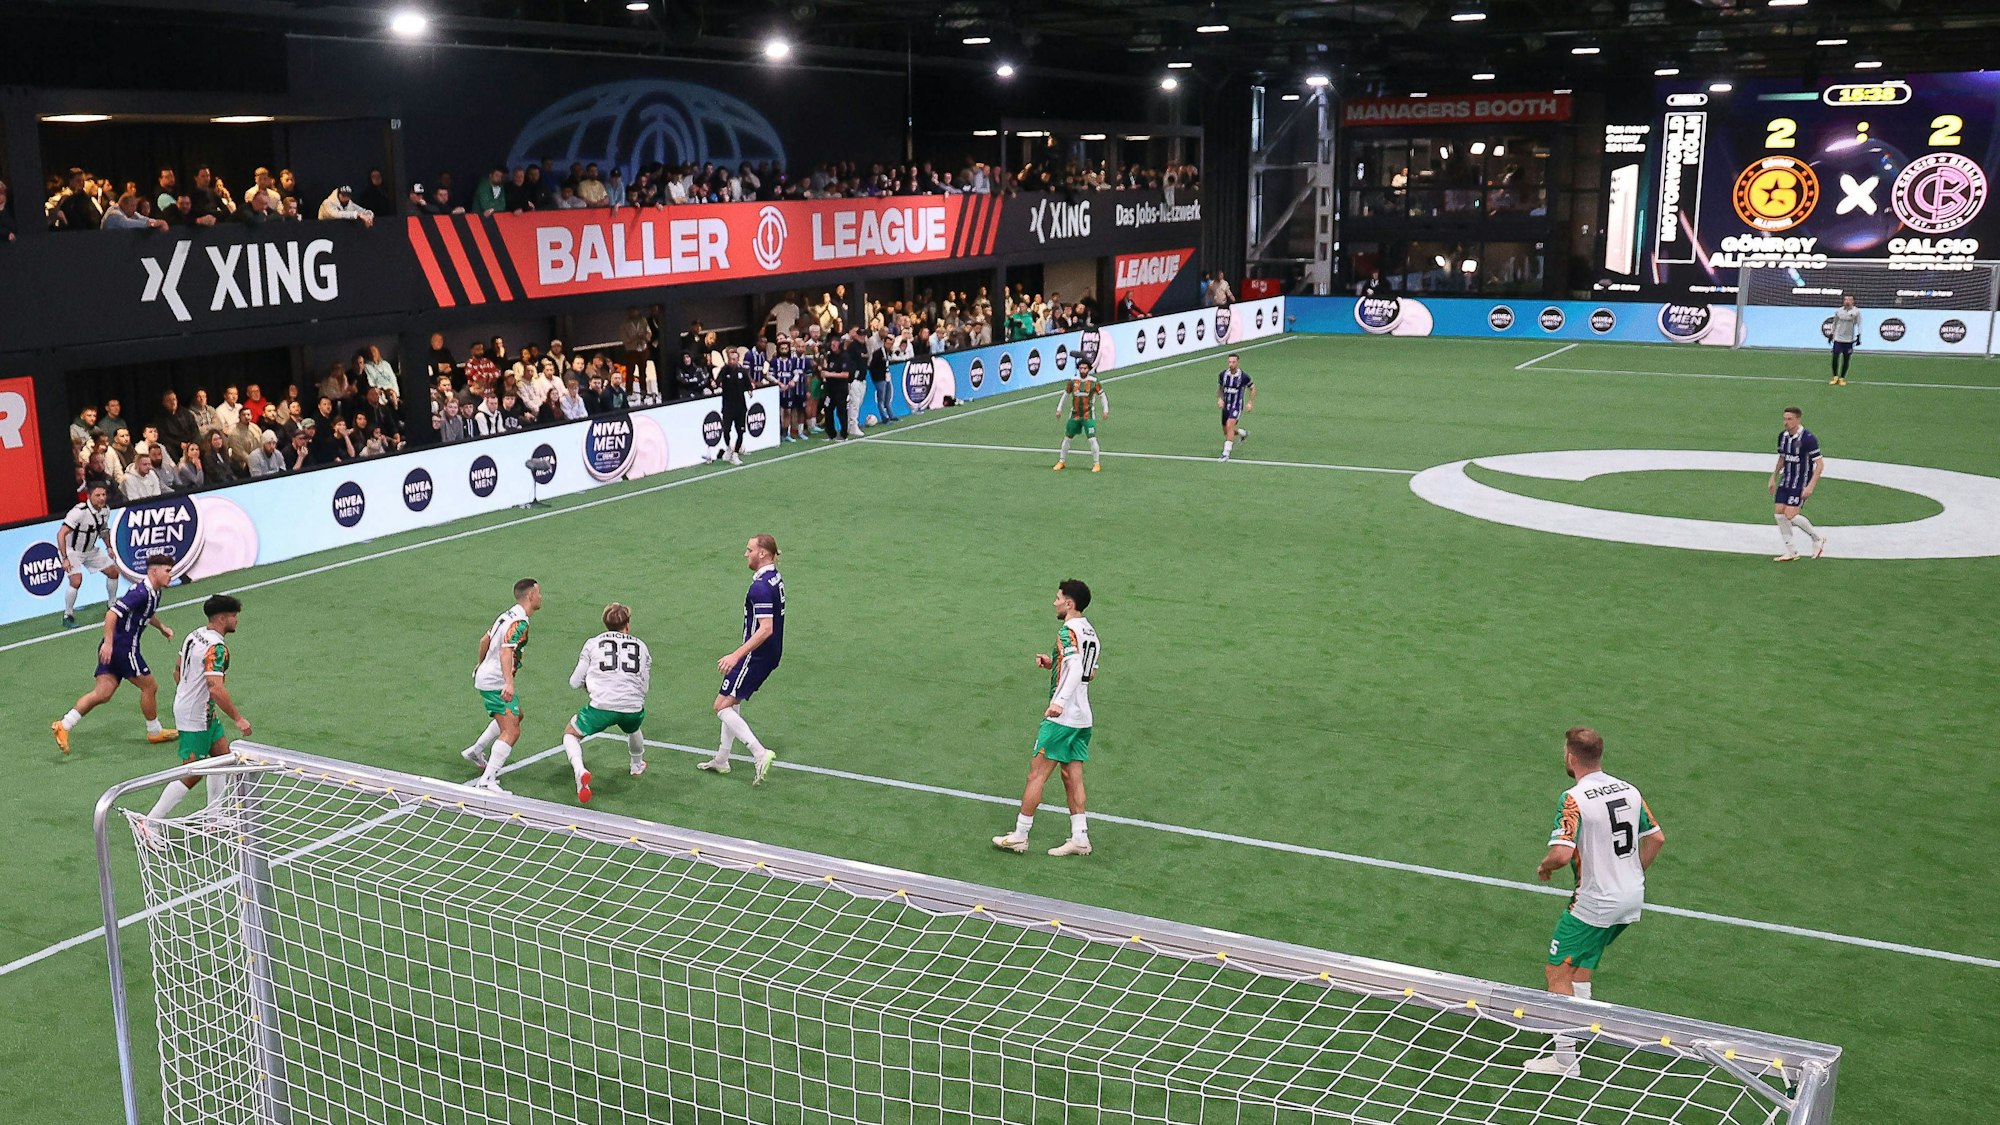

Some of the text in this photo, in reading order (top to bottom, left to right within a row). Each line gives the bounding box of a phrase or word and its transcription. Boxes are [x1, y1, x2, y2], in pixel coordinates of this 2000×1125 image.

[1347, 99, 1556, 120] MANAGERS BOOTH
[1765, 118, 1797, 149] 2
[1928, 114, 1963, 146] 2
[1898, 157, 1937, 188] CALCIO
[1050, 200, 1090, 239] XING
[1116, 203, 1135, 226] Das
[812, 206, 946, 261] LEAGUE
[536, 217, 731, 286] BALLER
[1721, 234, 1817, 253] GÖNRGY
[1888, 238, 1979, 254] CALCIO
[205, 238, 339, 311] XING
[1116, 254, 1181, 289] LEAGUE
[1364, 299, 1398, 310] NIVEA
[1364, 307, 1393, 318] MEN
[1669, 305, 1707, 318] NIVEA
[1669, 314, 1702, 326] MEN
[909, 363, 933, 374] NIVEA
[909, 374, 931, 386] MEN
[747, 412, 766, 423] NIVEA
[749, 420, 763, 430] MEN
[592, 420, 631, 437] NIVEA
[703, 422, 723, 432] NIVEA
[706, 429, 720, 440] MEN
[593, 434, 626, 452] MEN
[471, 467, 497, 482] NIVEA
[405, 480, 432, 496] NIVEA
[474, 477, 493, 490] MEN
[334, 494, 363, 510] NIVEA
[408, 490, 428, 503] MEN
[127, 505, 192, 528] NIVEA
[338, 504, 360, 519] MEN
[129, 524, 184, 548] MEN
[23, 557, 62, 576] NIVEA
[29, 570, 58, 586] MEN
[598, 640, 641, 674] 33
[1081, 640, 1097, 683] 10
[722, 678, 730, 691] 9
[1606, 798, 1636, 859] 5
[1550, 939, 1560, 956] 5
